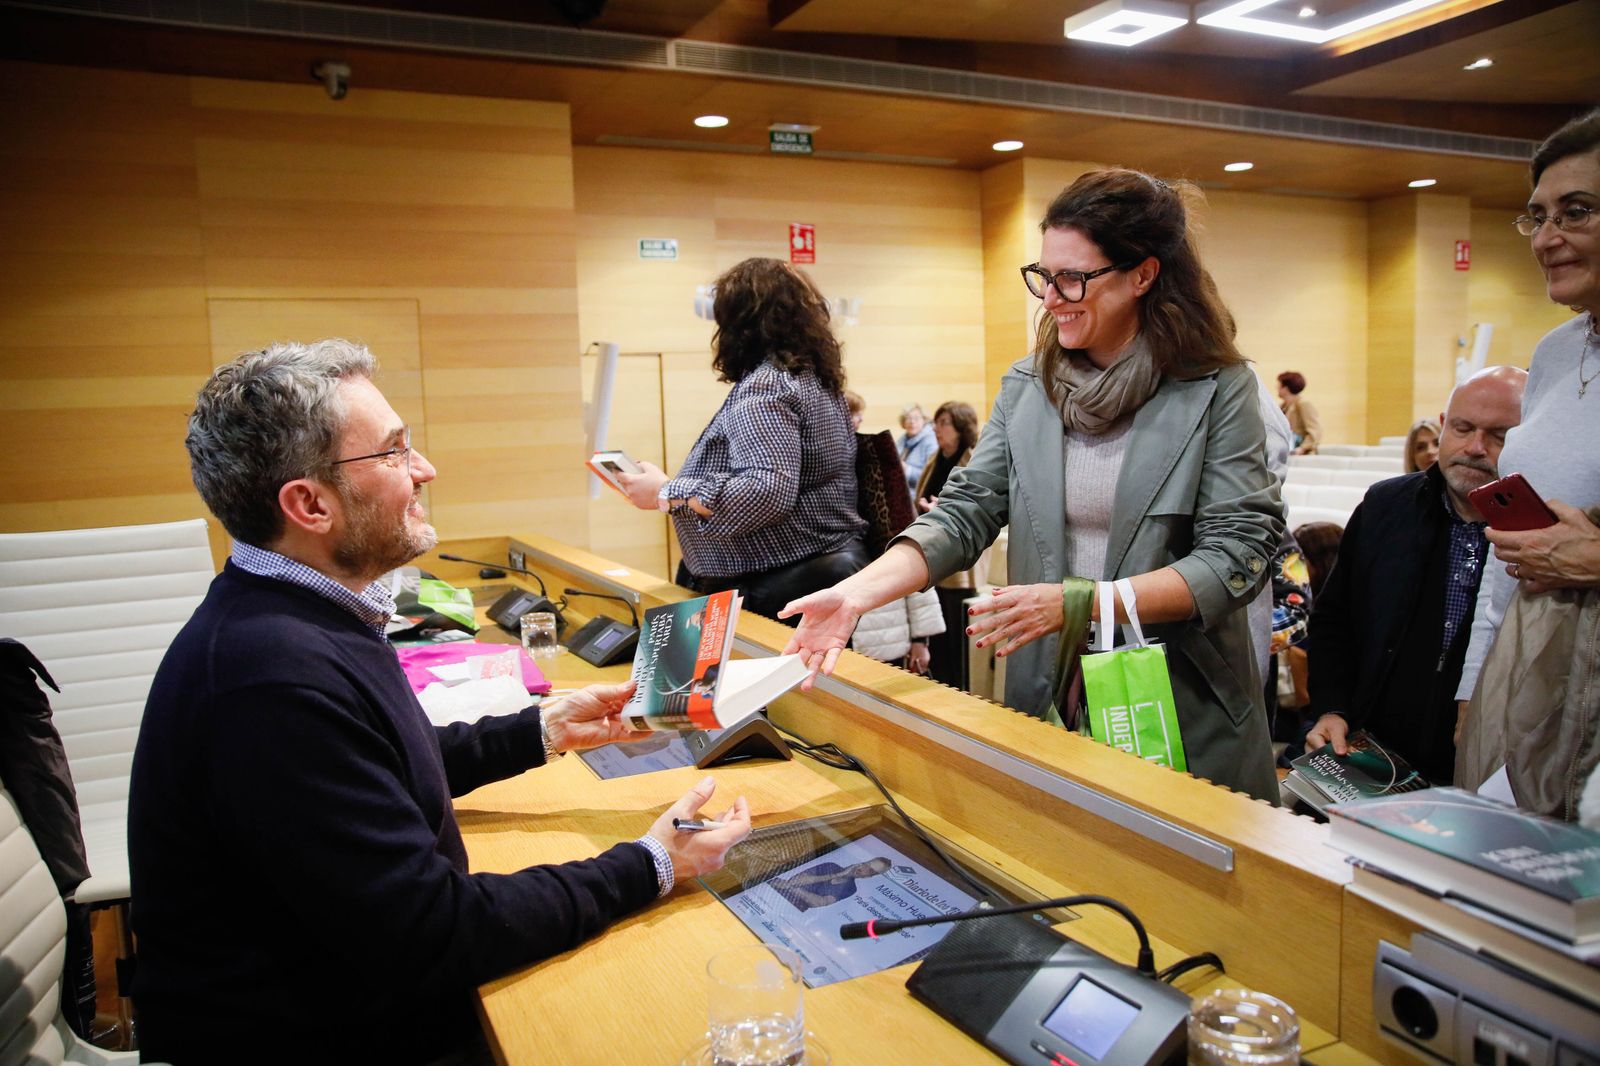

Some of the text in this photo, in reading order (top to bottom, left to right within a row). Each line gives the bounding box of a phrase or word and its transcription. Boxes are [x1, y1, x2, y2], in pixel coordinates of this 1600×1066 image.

[648, 614, 660, 644] PARÍS
[662, 612, 674, 647] TARDE
[647, 612, 667, 681] DESPERTABA
[1321, 754, 1345, 772] TARDE
[876, 884, 907, 908] Máximo
